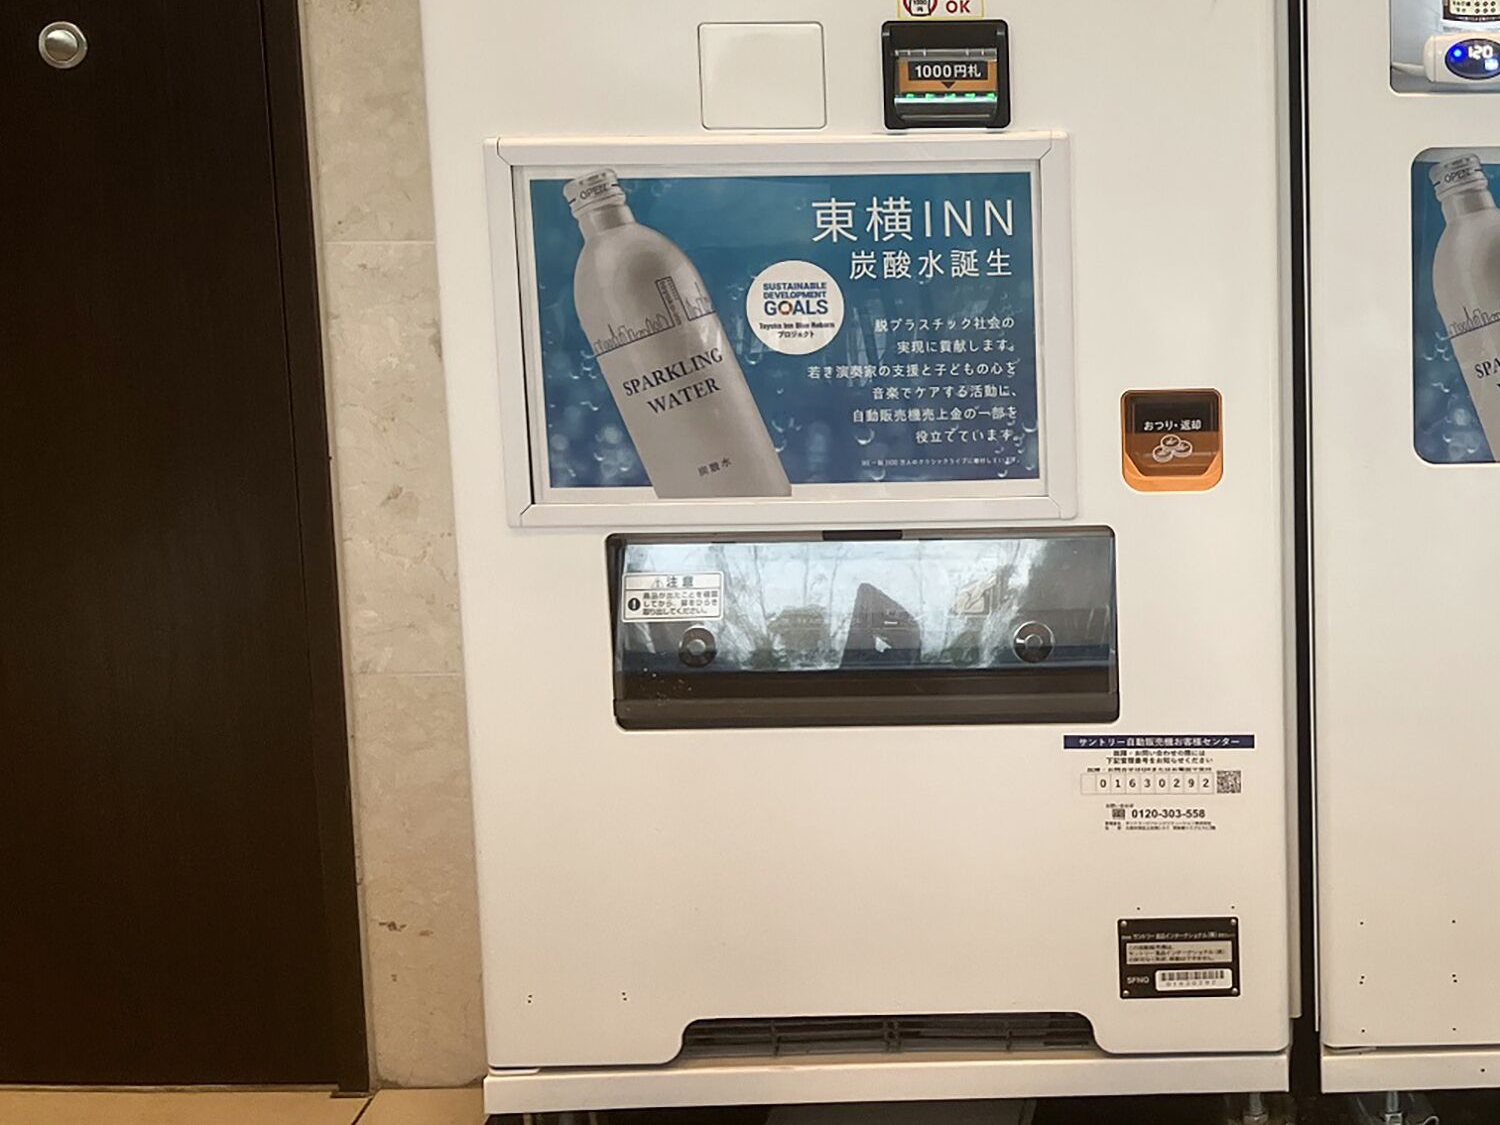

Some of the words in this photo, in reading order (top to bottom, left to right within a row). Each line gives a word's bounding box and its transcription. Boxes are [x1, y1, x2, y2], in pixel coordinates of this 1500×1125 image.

[946, 0, 971, 14] OK
[914, 63, 982, 79] 1000円札
[811, 196, 1015, 243] 東横INN
[849, 248, 1012, 281] 炭酸水誕生
[763, 282, 827, 290] SUSTAINABLE
[763, 291, 827, 299] DEVELOPMENT
[764, 299, 829, 316] GOALS
[874, 316, 1015, 332] 脱プラスチック社会の
[896, 339, 1015, 354] 実現に貢献します。
[622, 347, 724, 397] SPARKLING
[807, 361, 1017, 379] 若き演奏家の支援と子どもの心を
[646, 377, 721, 415] WATER
[872, 386, 1017, 400] 音楽でケアする活動に、
[852, 408, 1017, 423] 自動販売機売上金の一部を
[1143, 419, 1202, 431] おつり・返却
[1131, 808, 1206, 819] 0120-303-558
